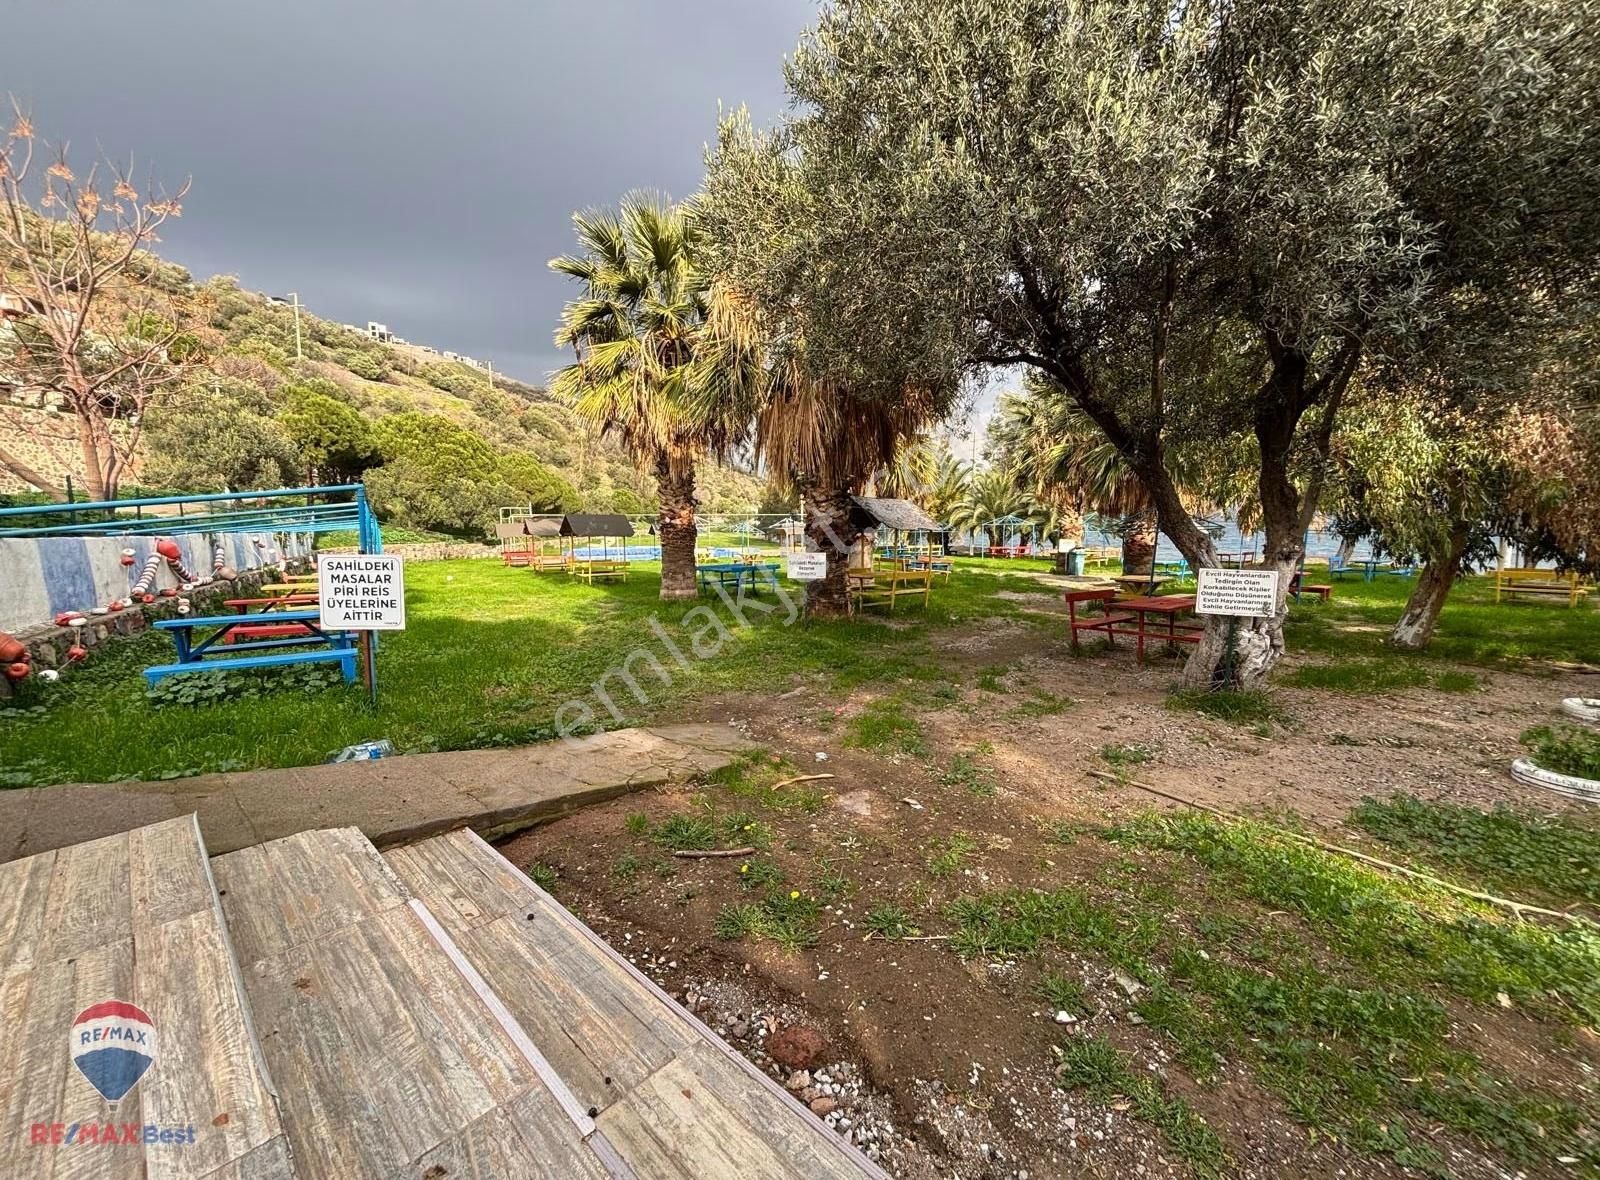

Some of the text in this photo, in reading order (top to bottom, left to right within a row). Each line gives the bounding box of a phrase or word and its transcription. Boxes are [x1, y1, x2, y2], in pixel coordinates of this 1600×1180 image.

[327, 560, 394, 570] SAHİLDEKİ
[331, 574, 391, 583] MASALAR
[334, 585, 389, 596] PİRİ REİS
[327, 598, 397, 608] ÜYELERİNE
[343, 610, 382, 620] AİTTİR
